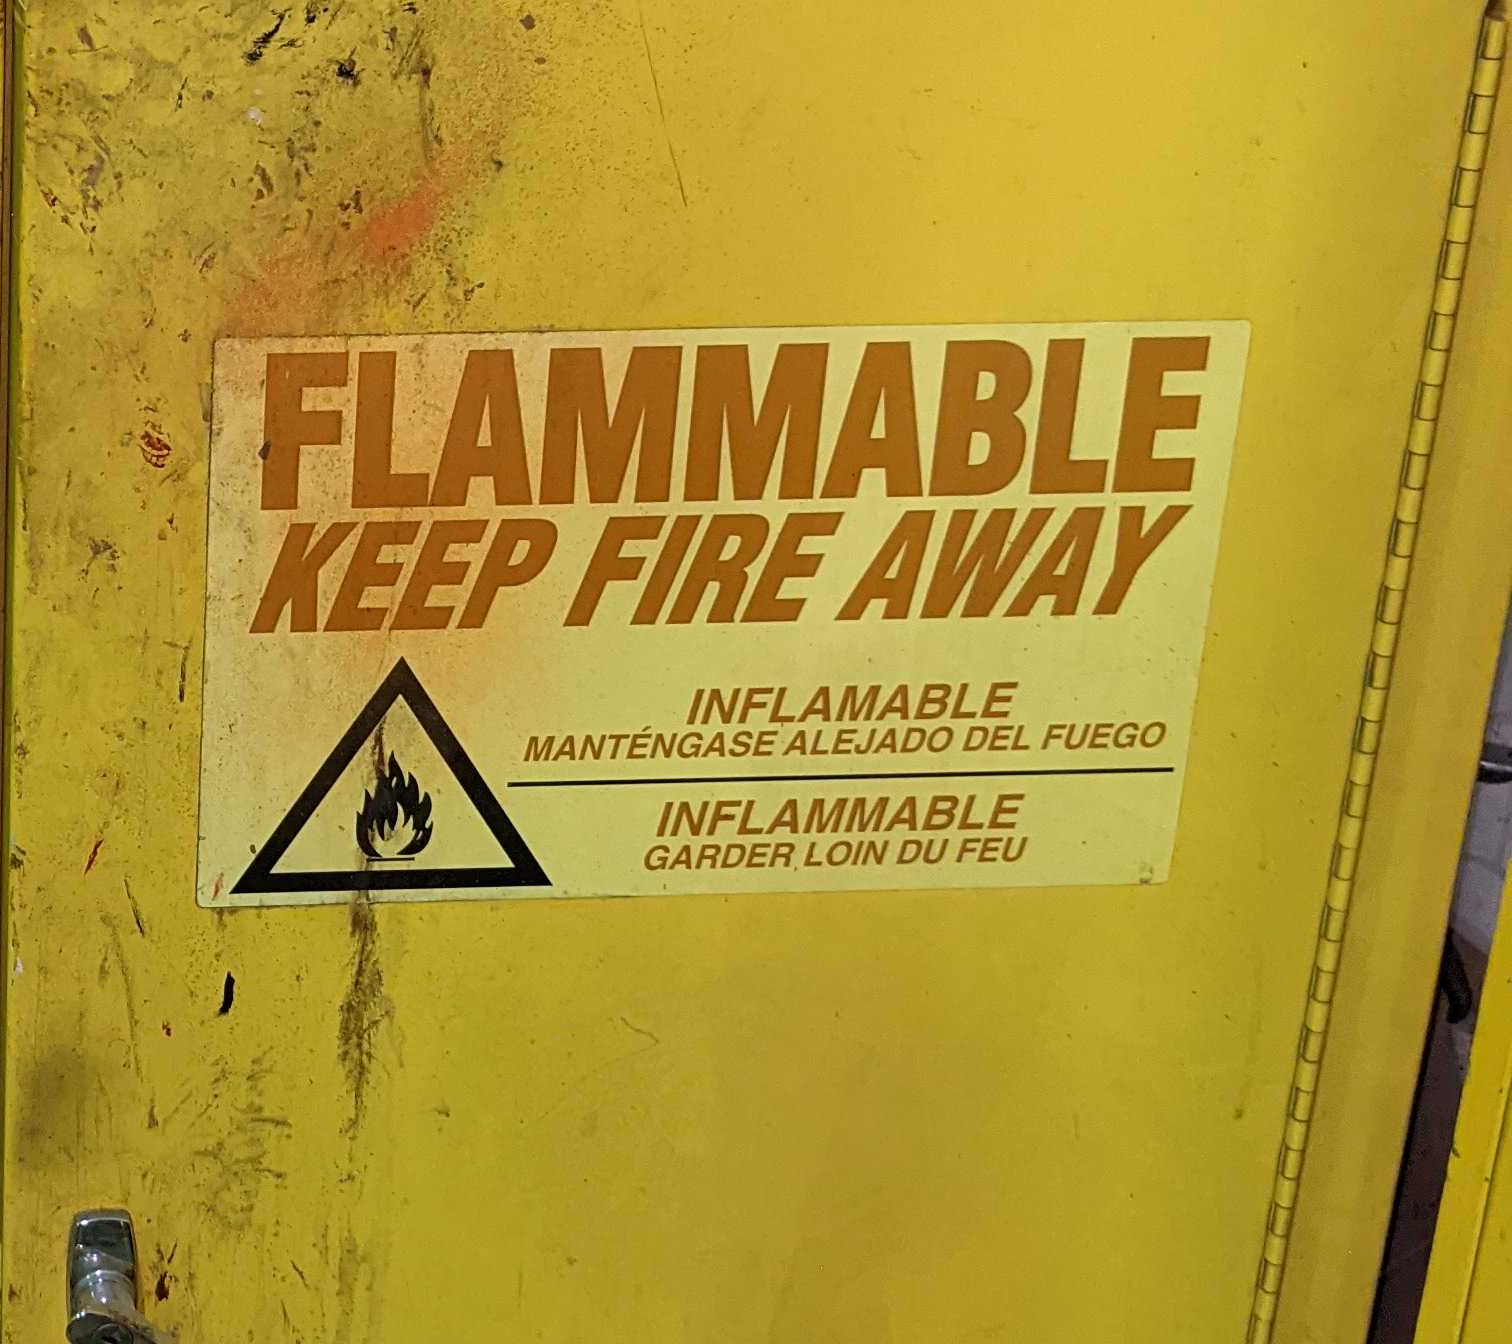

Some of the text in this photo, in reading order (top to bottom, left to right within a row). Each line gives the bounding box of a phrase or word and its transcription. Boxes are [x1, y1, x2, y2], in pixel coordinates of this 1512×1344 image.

[261, 336, 1212, 511] FLAMMABLE
[248, 504, 1194, 634] KEEP FIRE AWAY
[686, 681, 1019, 726] INFLAMABLE
[522, 721, 1168, 762] MANTÉNGASE ALEJADO DEL FUEGO
[655, 793, 1026, 838] INFLAMMABLE
[643, 836, 1029, 872] GARDER LOIN DU FEU
